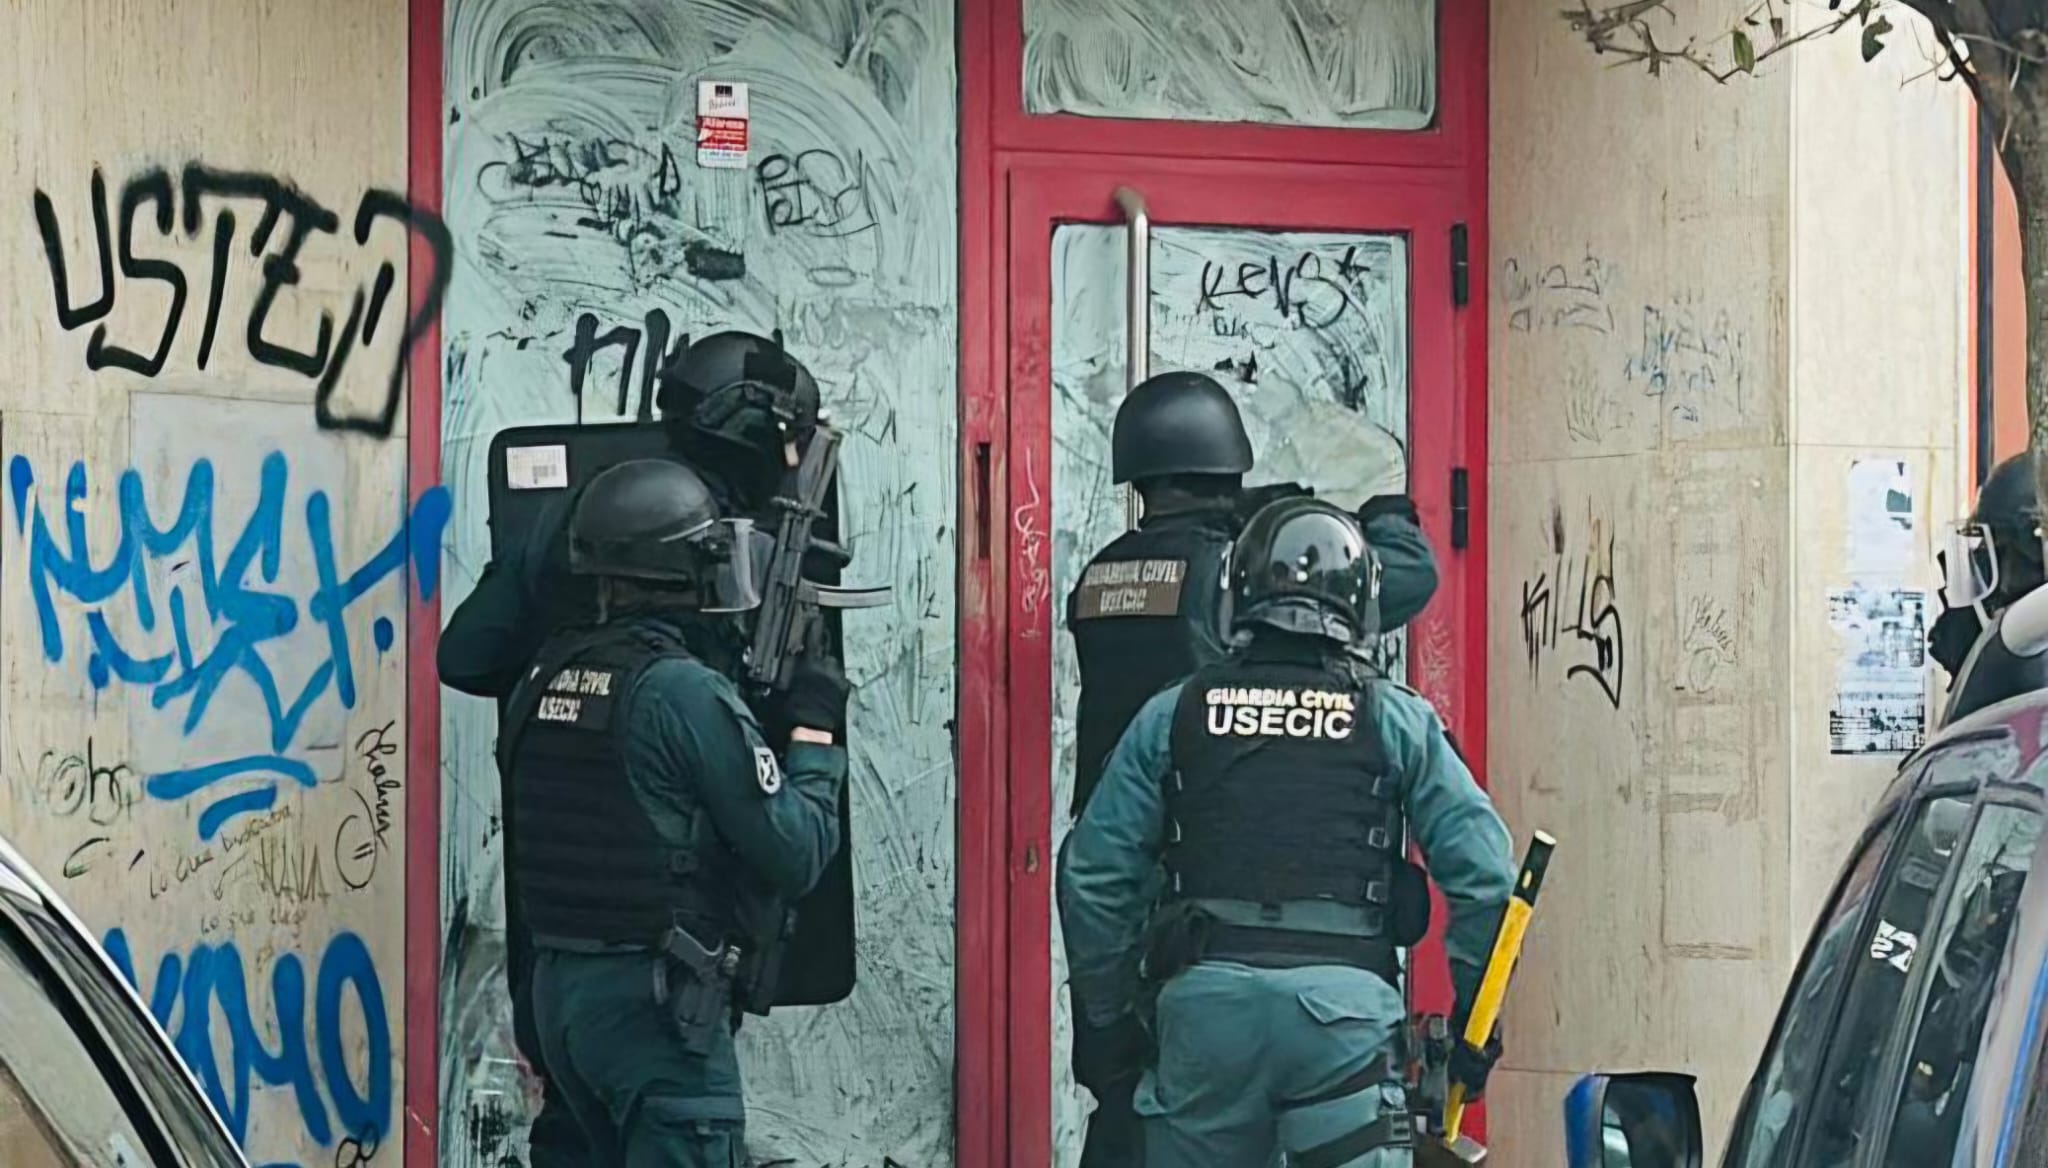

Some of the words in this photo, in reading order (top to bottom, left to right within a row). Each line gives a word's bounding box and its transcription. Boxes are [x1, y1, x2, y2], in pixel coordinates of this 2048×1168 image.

[1142, 560, 1180, 583] CIVIL
[1206, 688, 1298, 708] GUARDIA
[1300, 689, 1355, 711] CIVIL
[1208, 706, 1353, 740] USECIC
